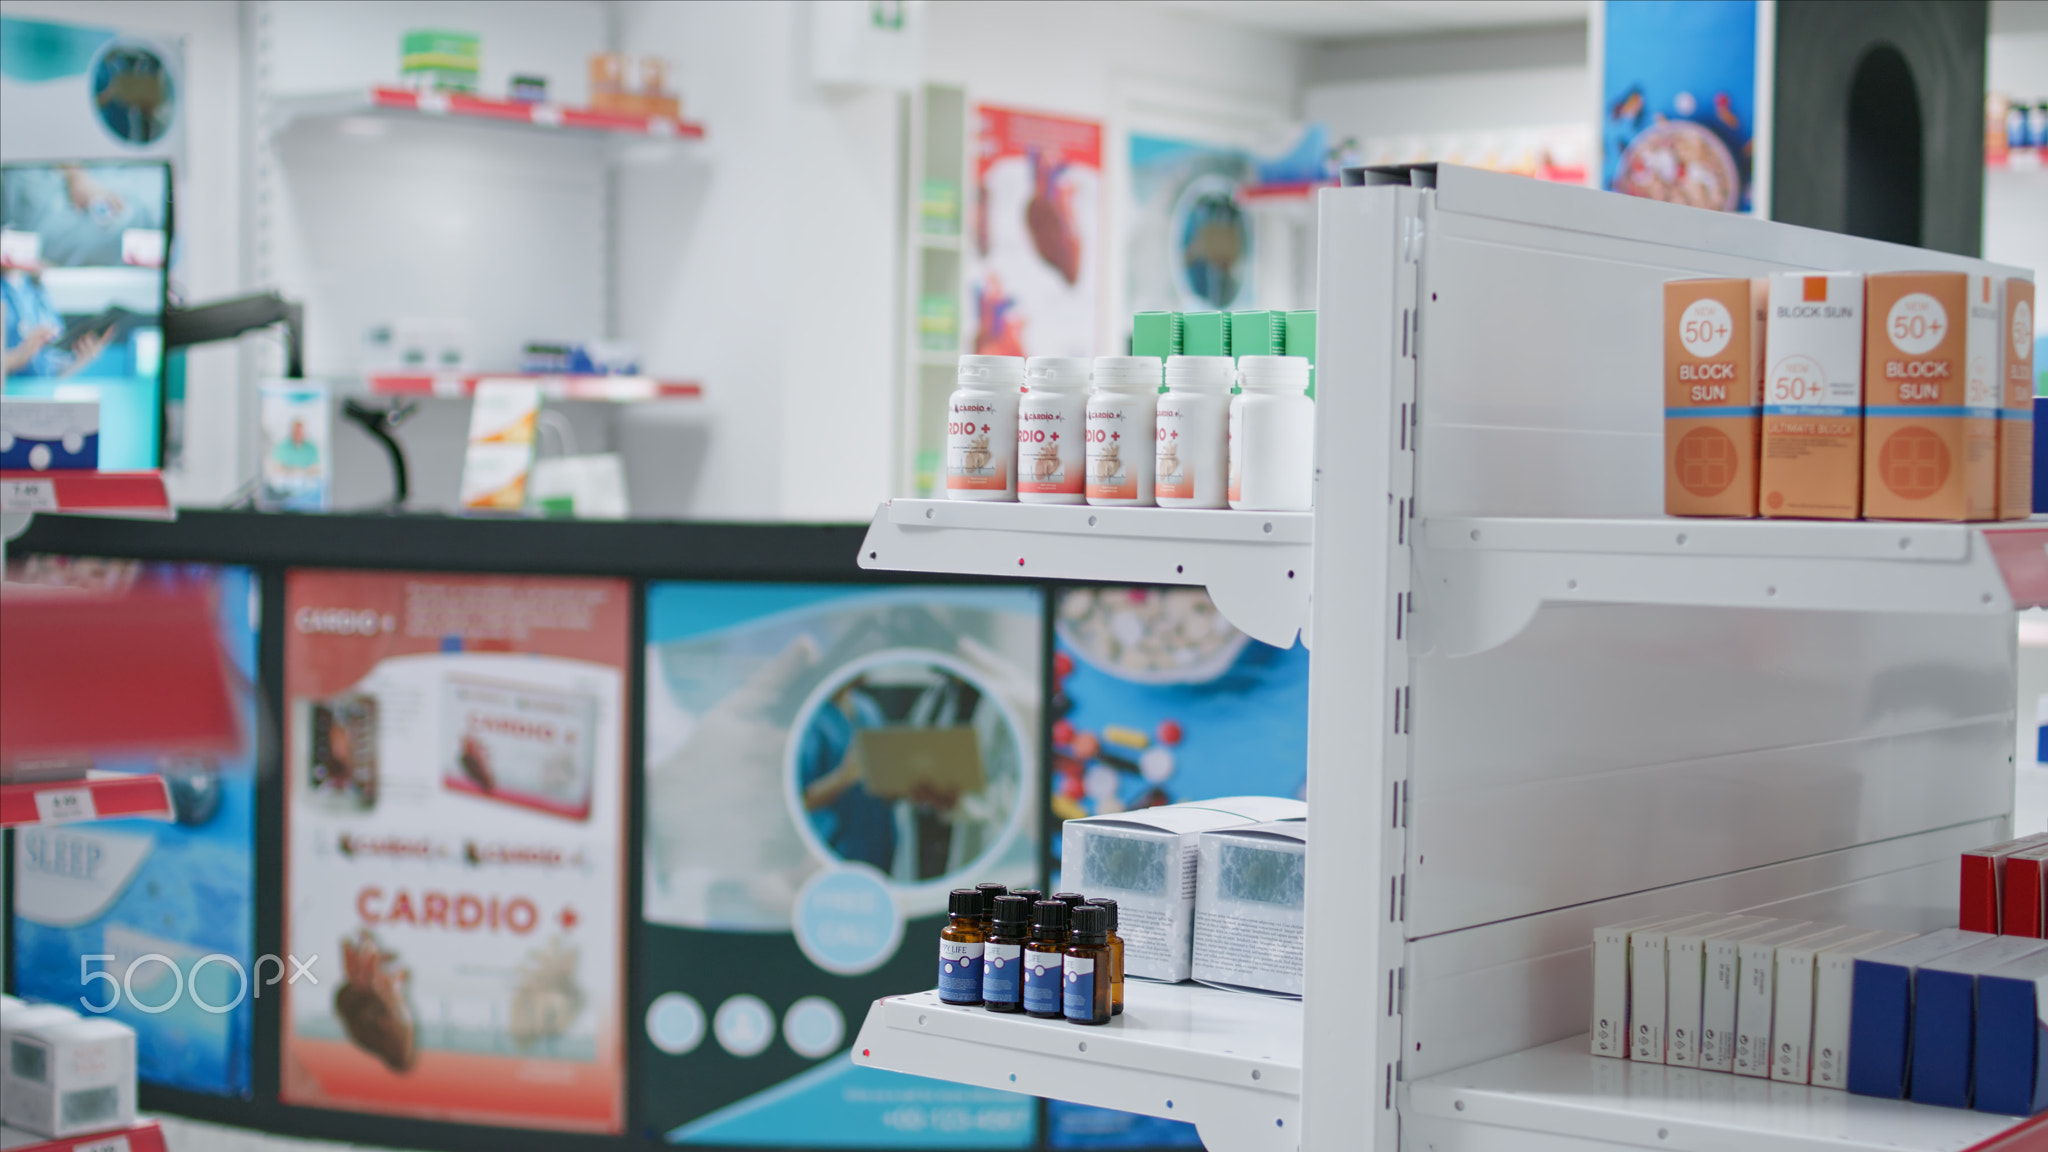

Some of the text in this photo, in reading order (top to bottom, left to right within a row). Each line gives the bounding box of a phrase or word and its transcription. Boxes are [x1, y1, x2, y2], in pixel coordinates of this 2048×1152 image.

[1777, 306, 1822, 319] BLOCK
[1823, 306, 1854, 319] SUN
[1684, 320, 1728, 343] 50+
[1893, 315, 1942, 340] 50+
[1679, 364, 1734, 380] BLOCK
[1886, 361, 1949, 378] BLOCK
[1691, 385, 1726, 401] SUN
[1774, 377, 1821, 401] 50+
[1898, 383, 1939, 400] SUN
[959, 404, 985, 413] CARDIO
[25, 830, 103, 881] SLEEP
[355, 886, 539, 935] CARDIO
[951, 945, 967, 954] LIFE
